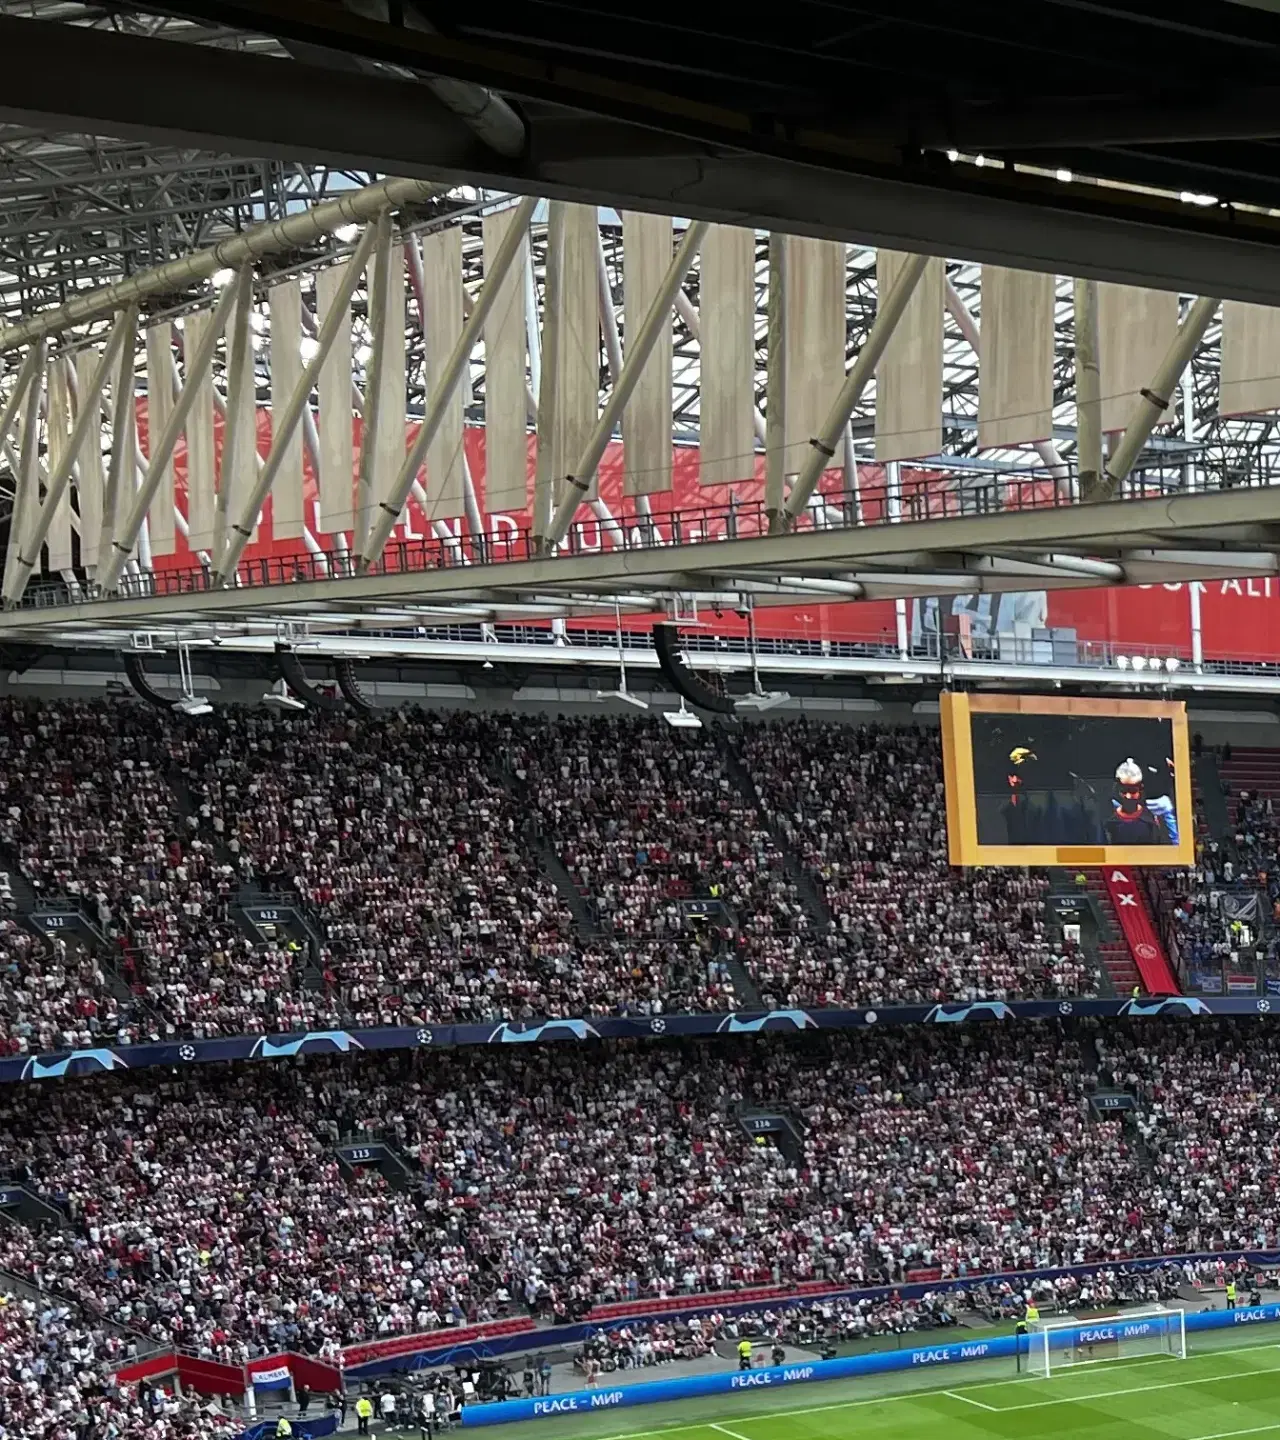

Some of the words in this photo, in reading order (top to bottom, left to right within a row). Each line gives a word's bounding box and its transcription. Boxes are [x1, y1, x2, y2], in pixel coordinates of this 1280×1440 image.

[352, 1149, 369, 1159] 113
[1234, 1309, 1265, 1322] PEACE
[1079, 1328, 1114, 1342] PEACE
[912, 1349, 950, 1364] PEACE
[732, 1371, 771, 1388] PEACE
[534, 1397, 577, 1414] PEACE
